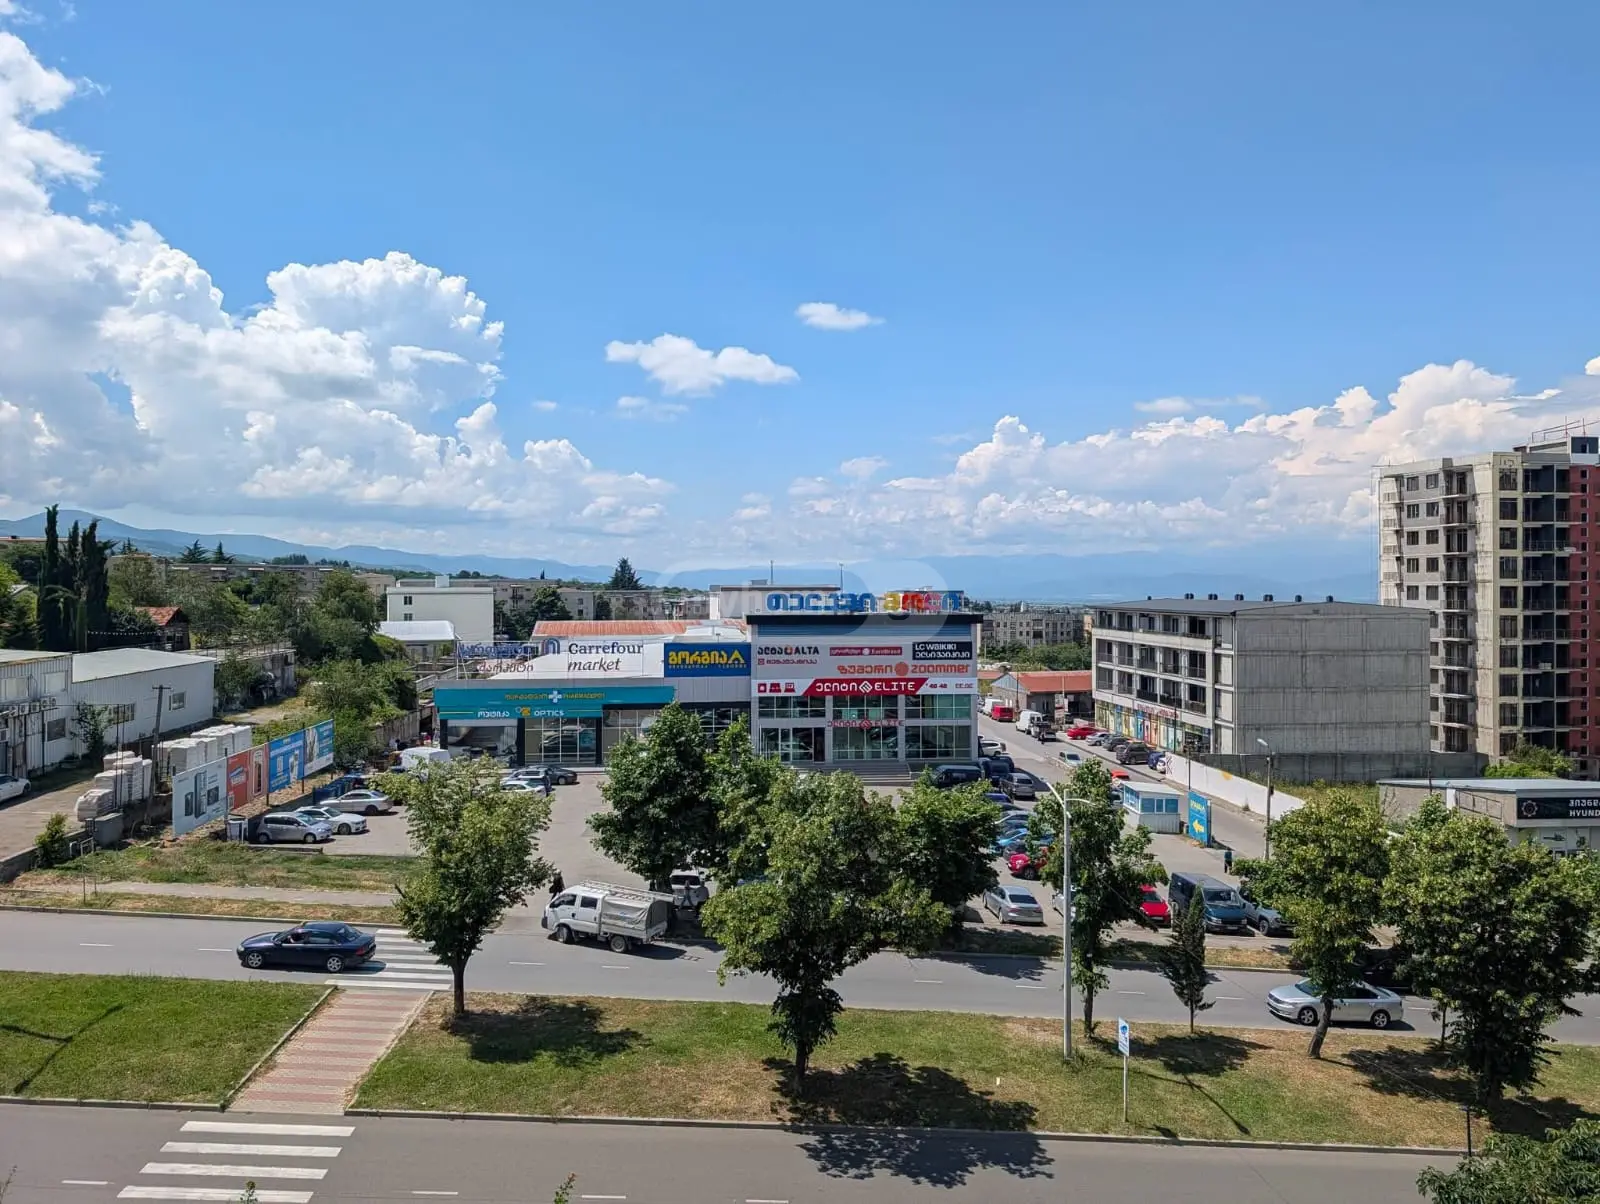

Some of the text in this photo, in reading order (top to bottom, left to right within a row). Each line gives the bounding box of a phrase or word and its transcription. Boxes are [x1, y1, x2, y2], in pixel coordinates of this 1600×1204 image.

[568, 642, 643, 655] Carrefour
[757, 646, 783, 655] ალტა
[794, 646, 820, 655] ALTA
[668, 651, 728, 665] გორგია
[567, 657, 621, 673] market
[837, 664, 893, 675] ზუმერი
[911, 664, 970, 674] zoommer
[815, 682, 858, 692] ელიტი
[875, 681, 916, 692] ELITE
[534, 709, 564, 717] OPTICS
